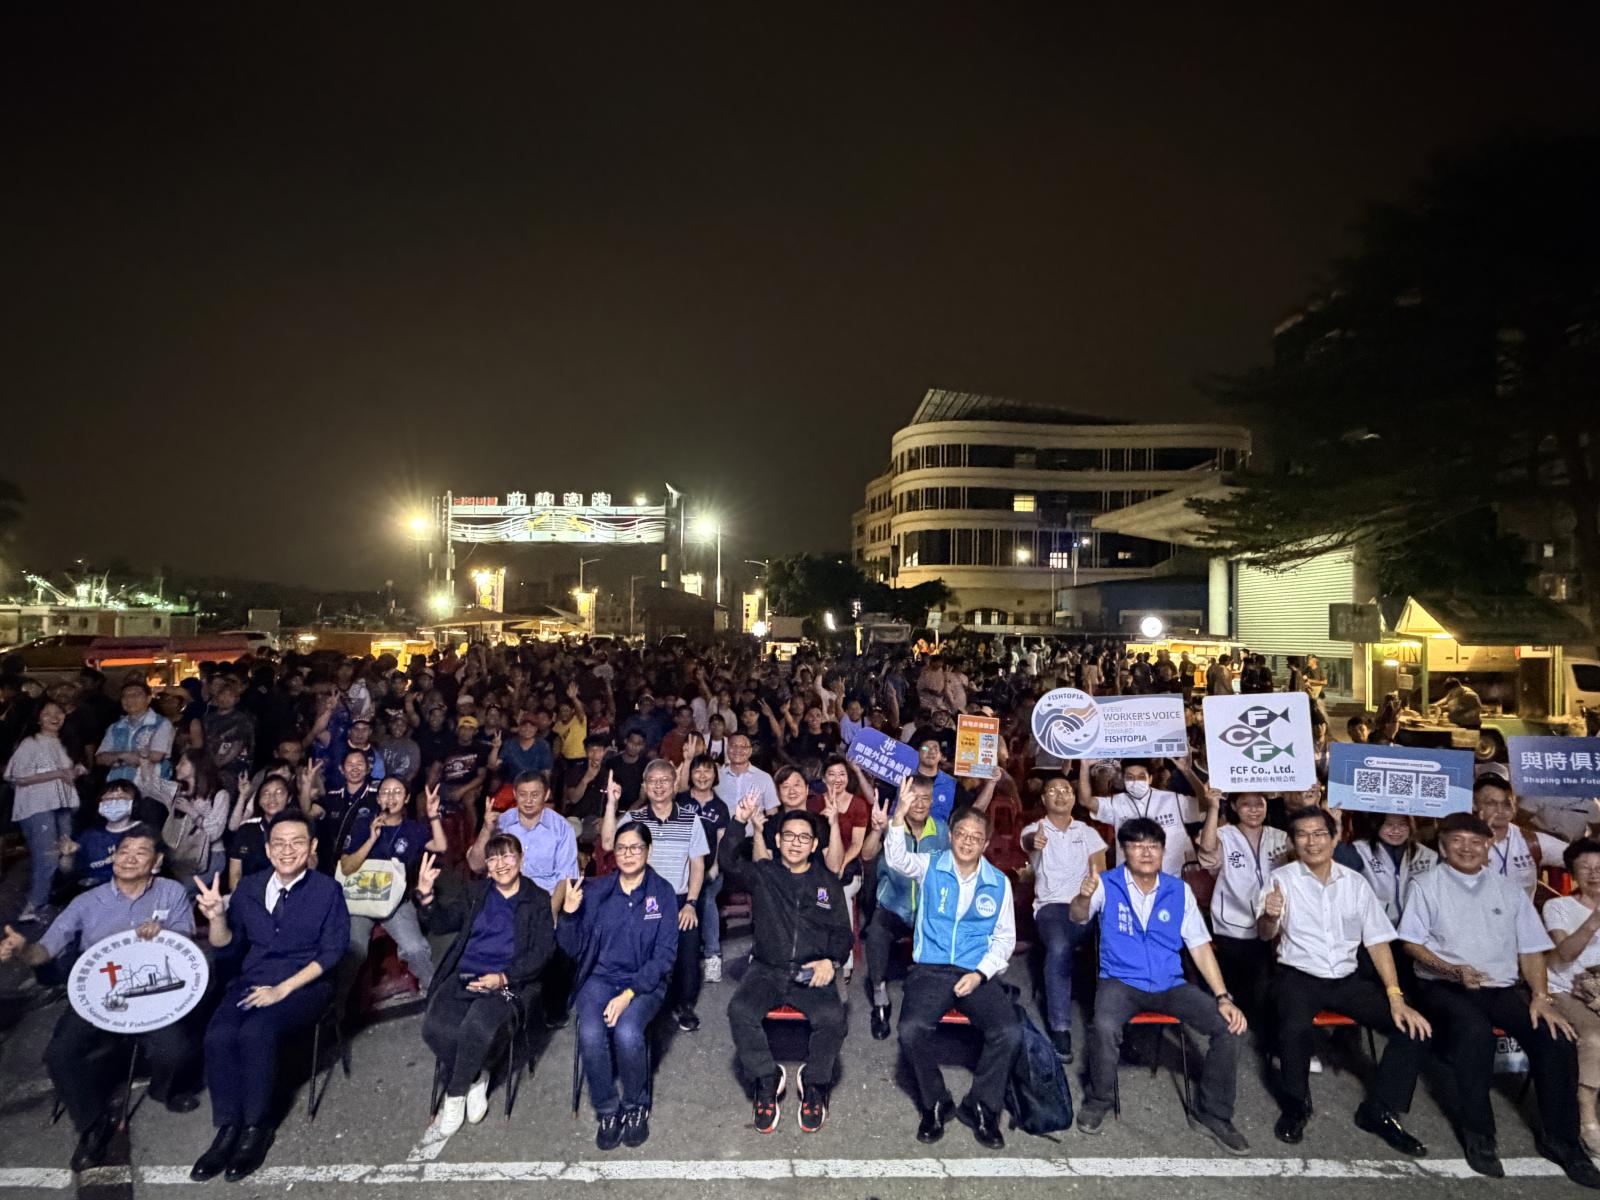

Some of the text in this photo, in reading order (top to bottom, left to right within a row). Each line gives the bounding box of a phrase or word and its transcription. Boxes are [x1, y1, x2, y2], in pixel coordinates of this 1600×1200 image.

[507, 491, 611, 507] 前鎮漁港
[1048, 692, 1084, 701] FISHTOPIA
[1103, 711, 1181, 721] WORKER'S VOICE
[1105, 735, 1147, 743] FISHTOPIA
[1520, 751, 1600, 771] 與時俱
[1230, 764, 1295, 775] FCF Co., Ltd.
[1523, 776, 1561, 785] Shaping
